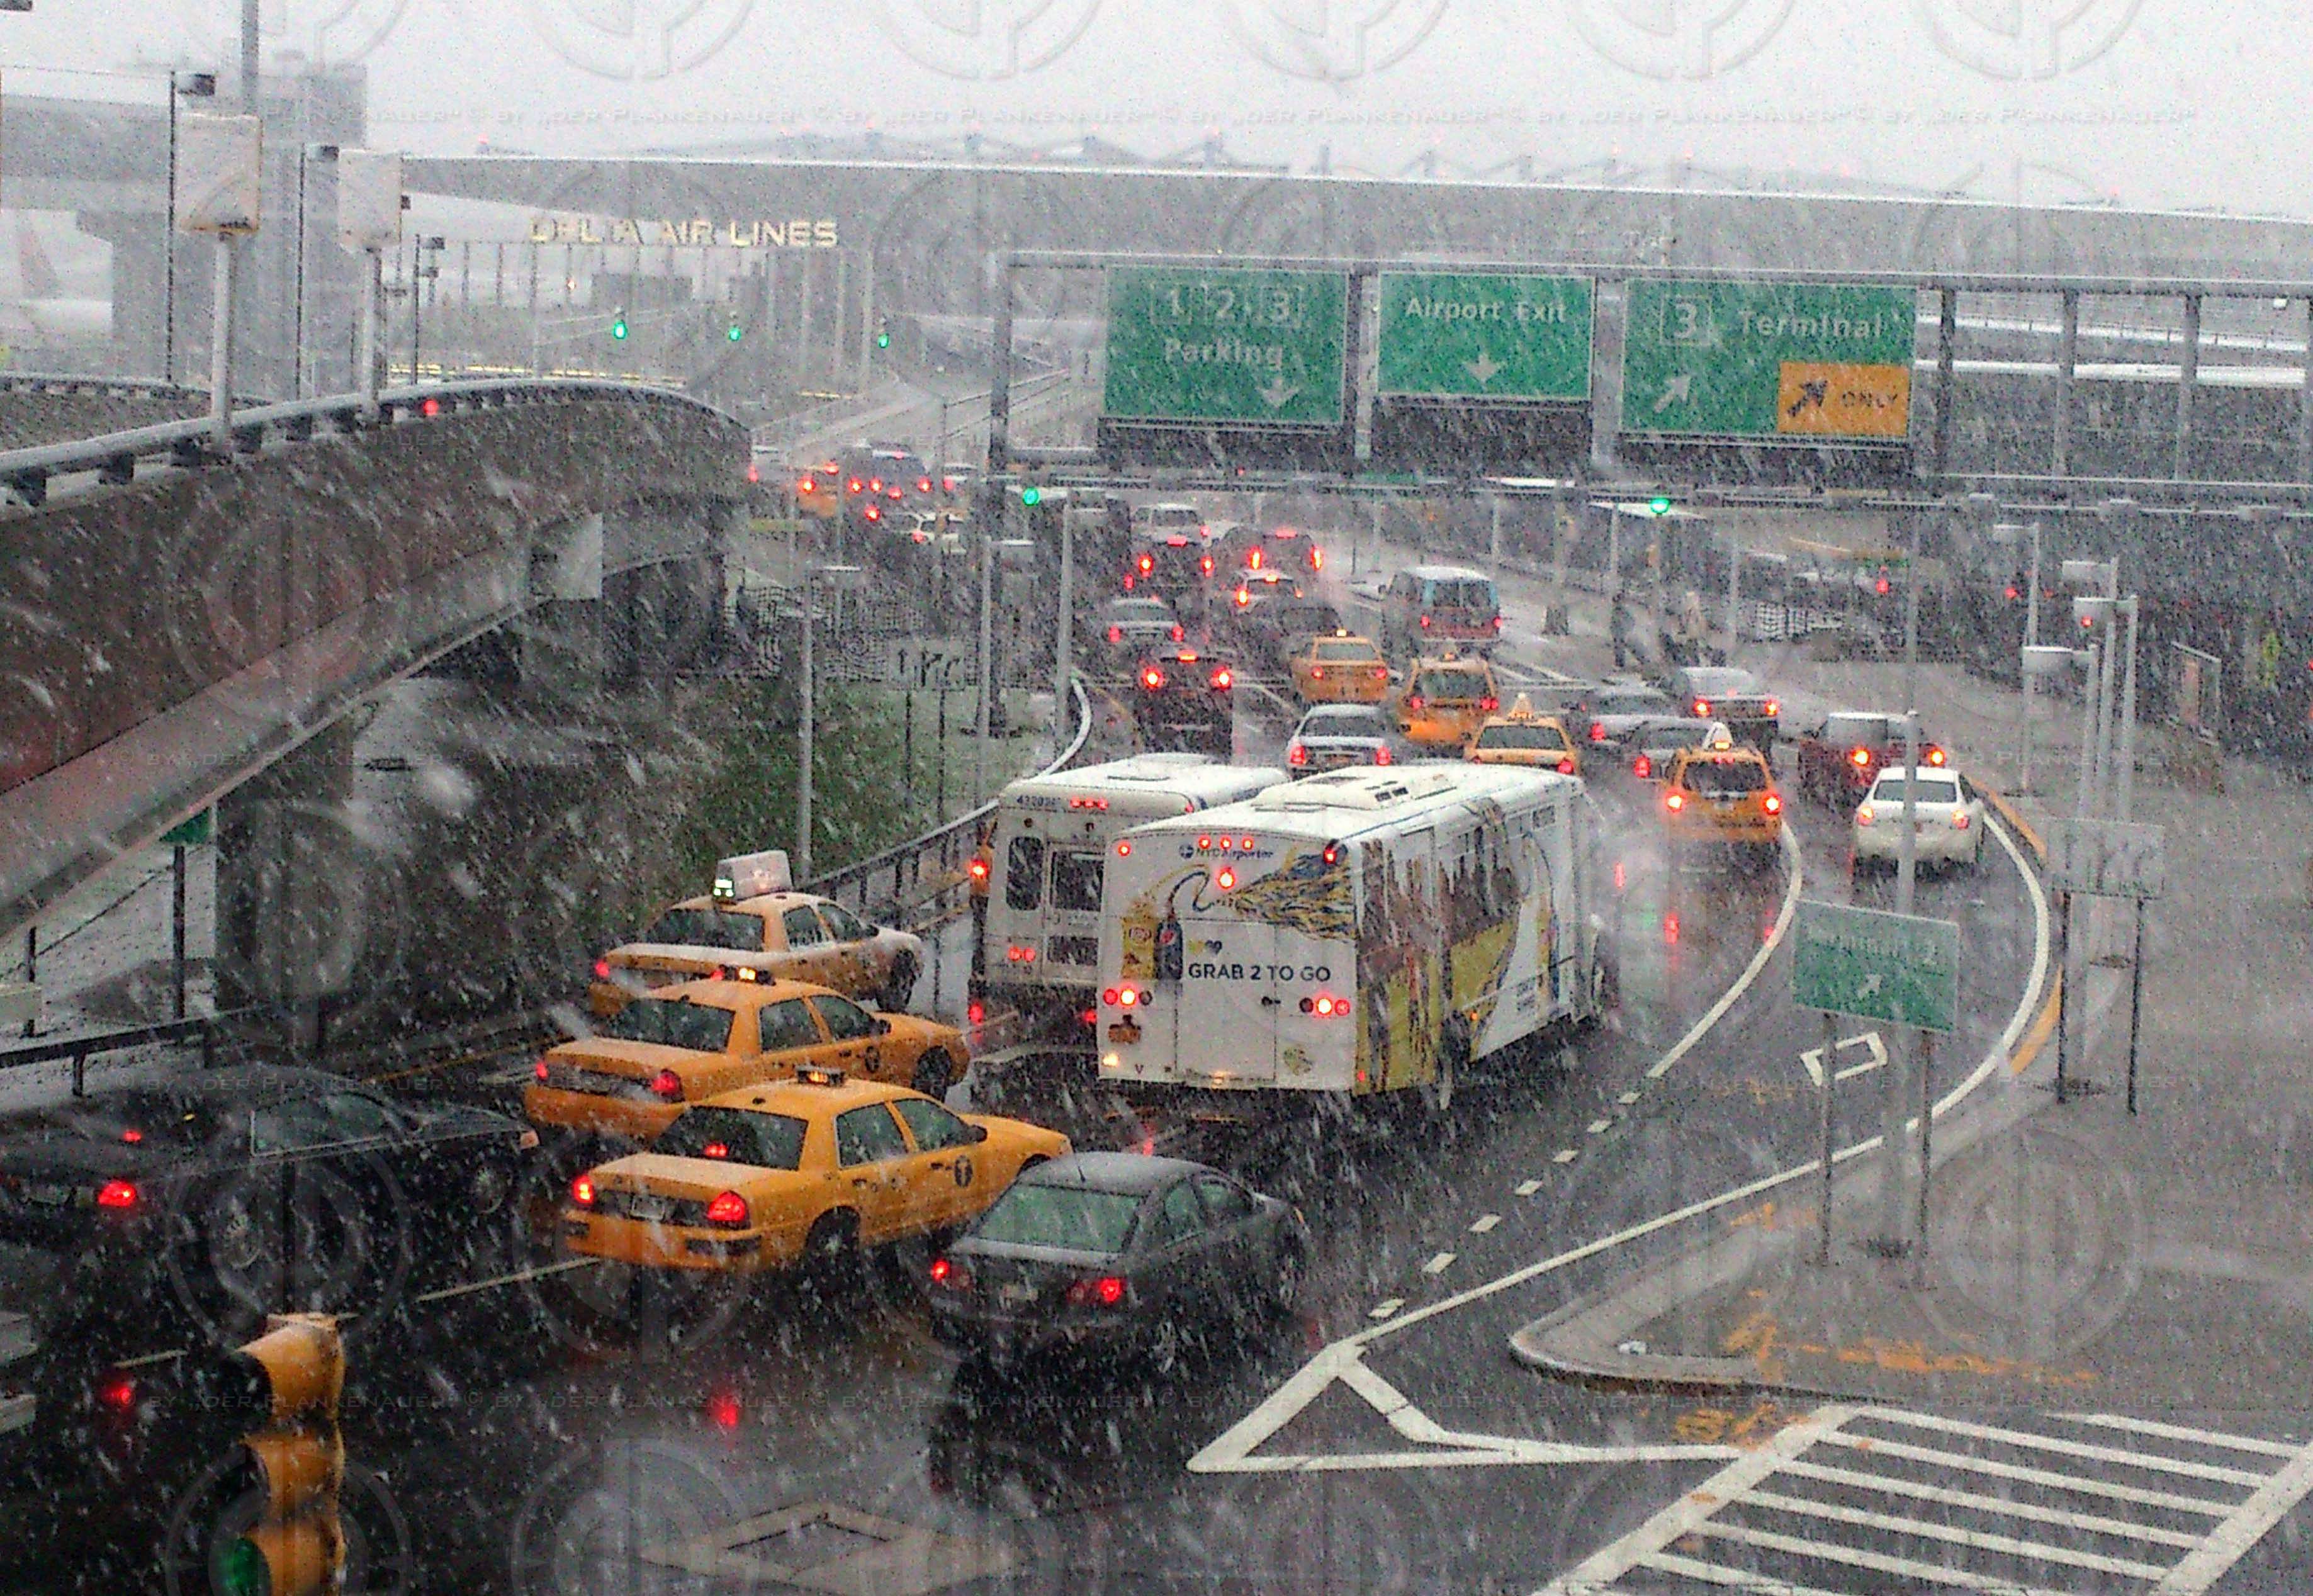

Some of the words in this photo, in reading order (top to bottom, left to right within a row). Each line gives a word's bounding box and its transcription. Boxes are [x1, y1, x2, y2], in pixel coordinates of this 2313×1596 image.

[664, 220, 714, 244] AIR
[729, 220, 840, 247] LINES
[1405, 297, 1502, 322] Airport
[1517, 298, 1567, 323] Exit
[1674, 301, 1697, 339] 3
[1738, 310, 1882, 339] Terminal
[1165, 336, 1283, 371] Parking
[1842, 390, 1898, 408] ONLY
[1188, 963, 1244, 979] GRAB
[1251, 965, 1261, 981] 2
[1267, 965, 1294, 981] TO
[1300, 965, 1331, 982] GO
